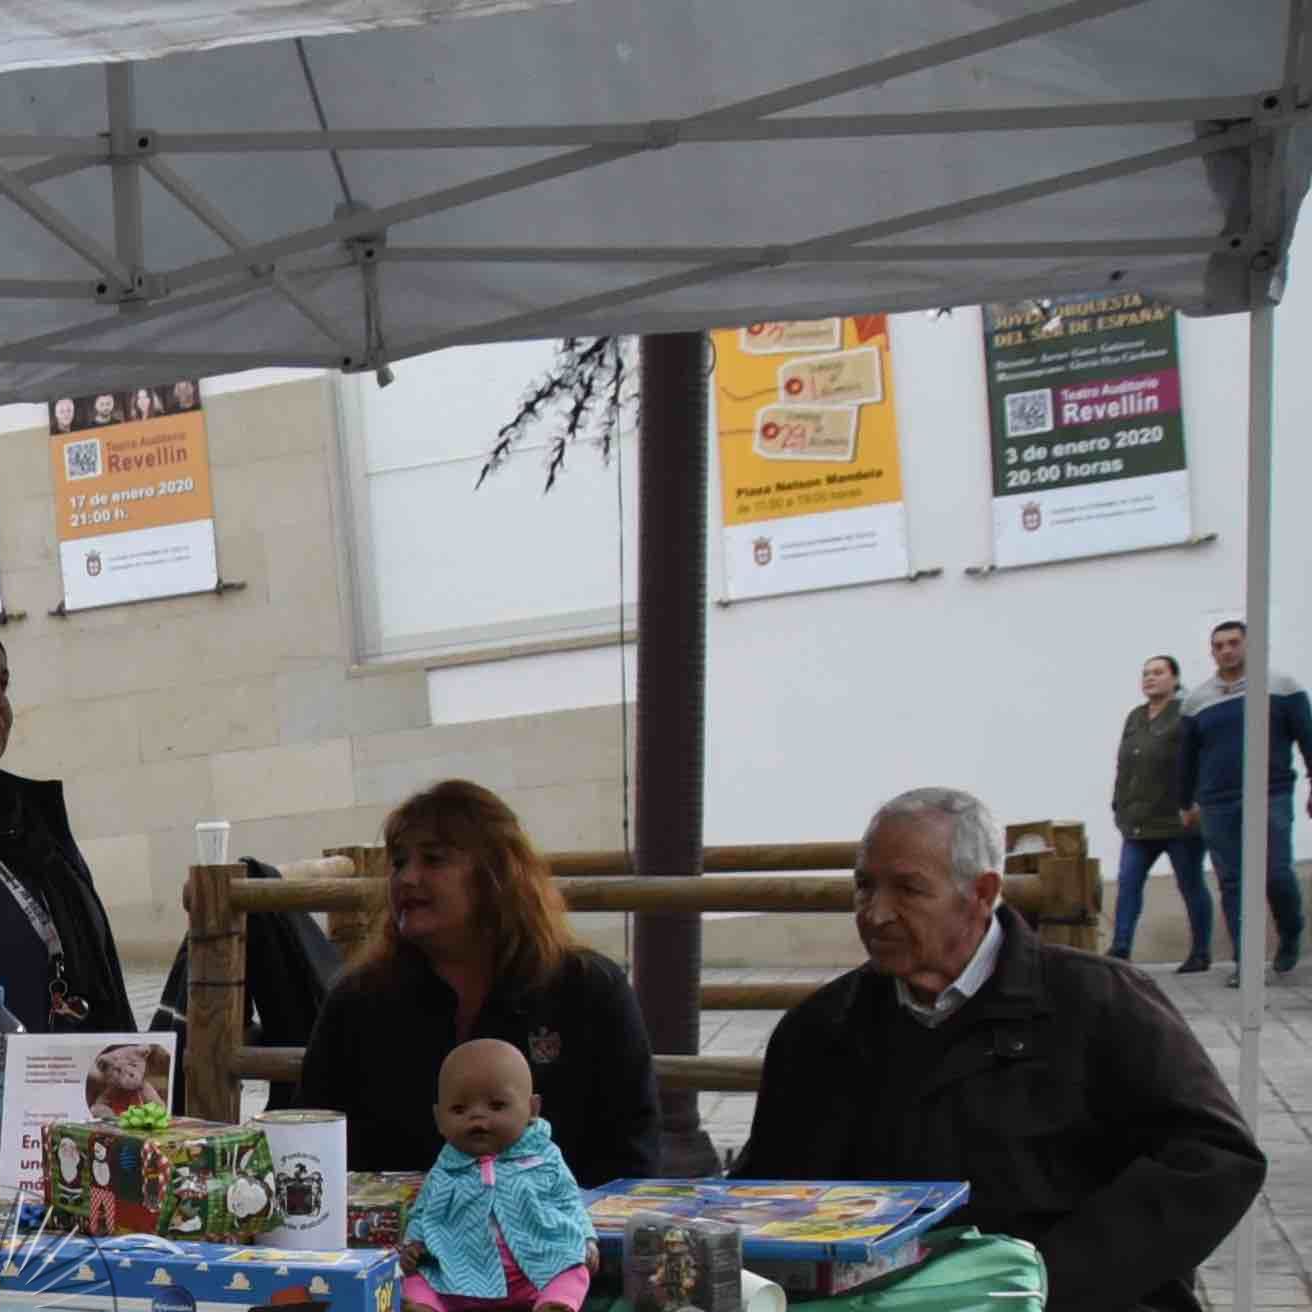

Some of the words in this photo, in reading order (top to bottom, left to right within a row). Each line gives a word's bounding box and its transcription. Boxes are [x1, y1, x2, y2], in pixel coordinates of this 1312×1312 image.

[1006, 448, 1018, 465] 3
[1022, 445, 1047, 462] de
[1052, 437, 1110, 457] enero
[1115, 426, 1164, 448] 2020
[1007, 465, 1060, 488] 20:00
[1066, 458, 1124, 478] horas
[70, 495, 85, 508] 17
[90, 495, 108, 506] de
[112, 488, 154, 503] enero
[160, 479, 193, 495] 2020
[21, 1159, 44, 1170] un
